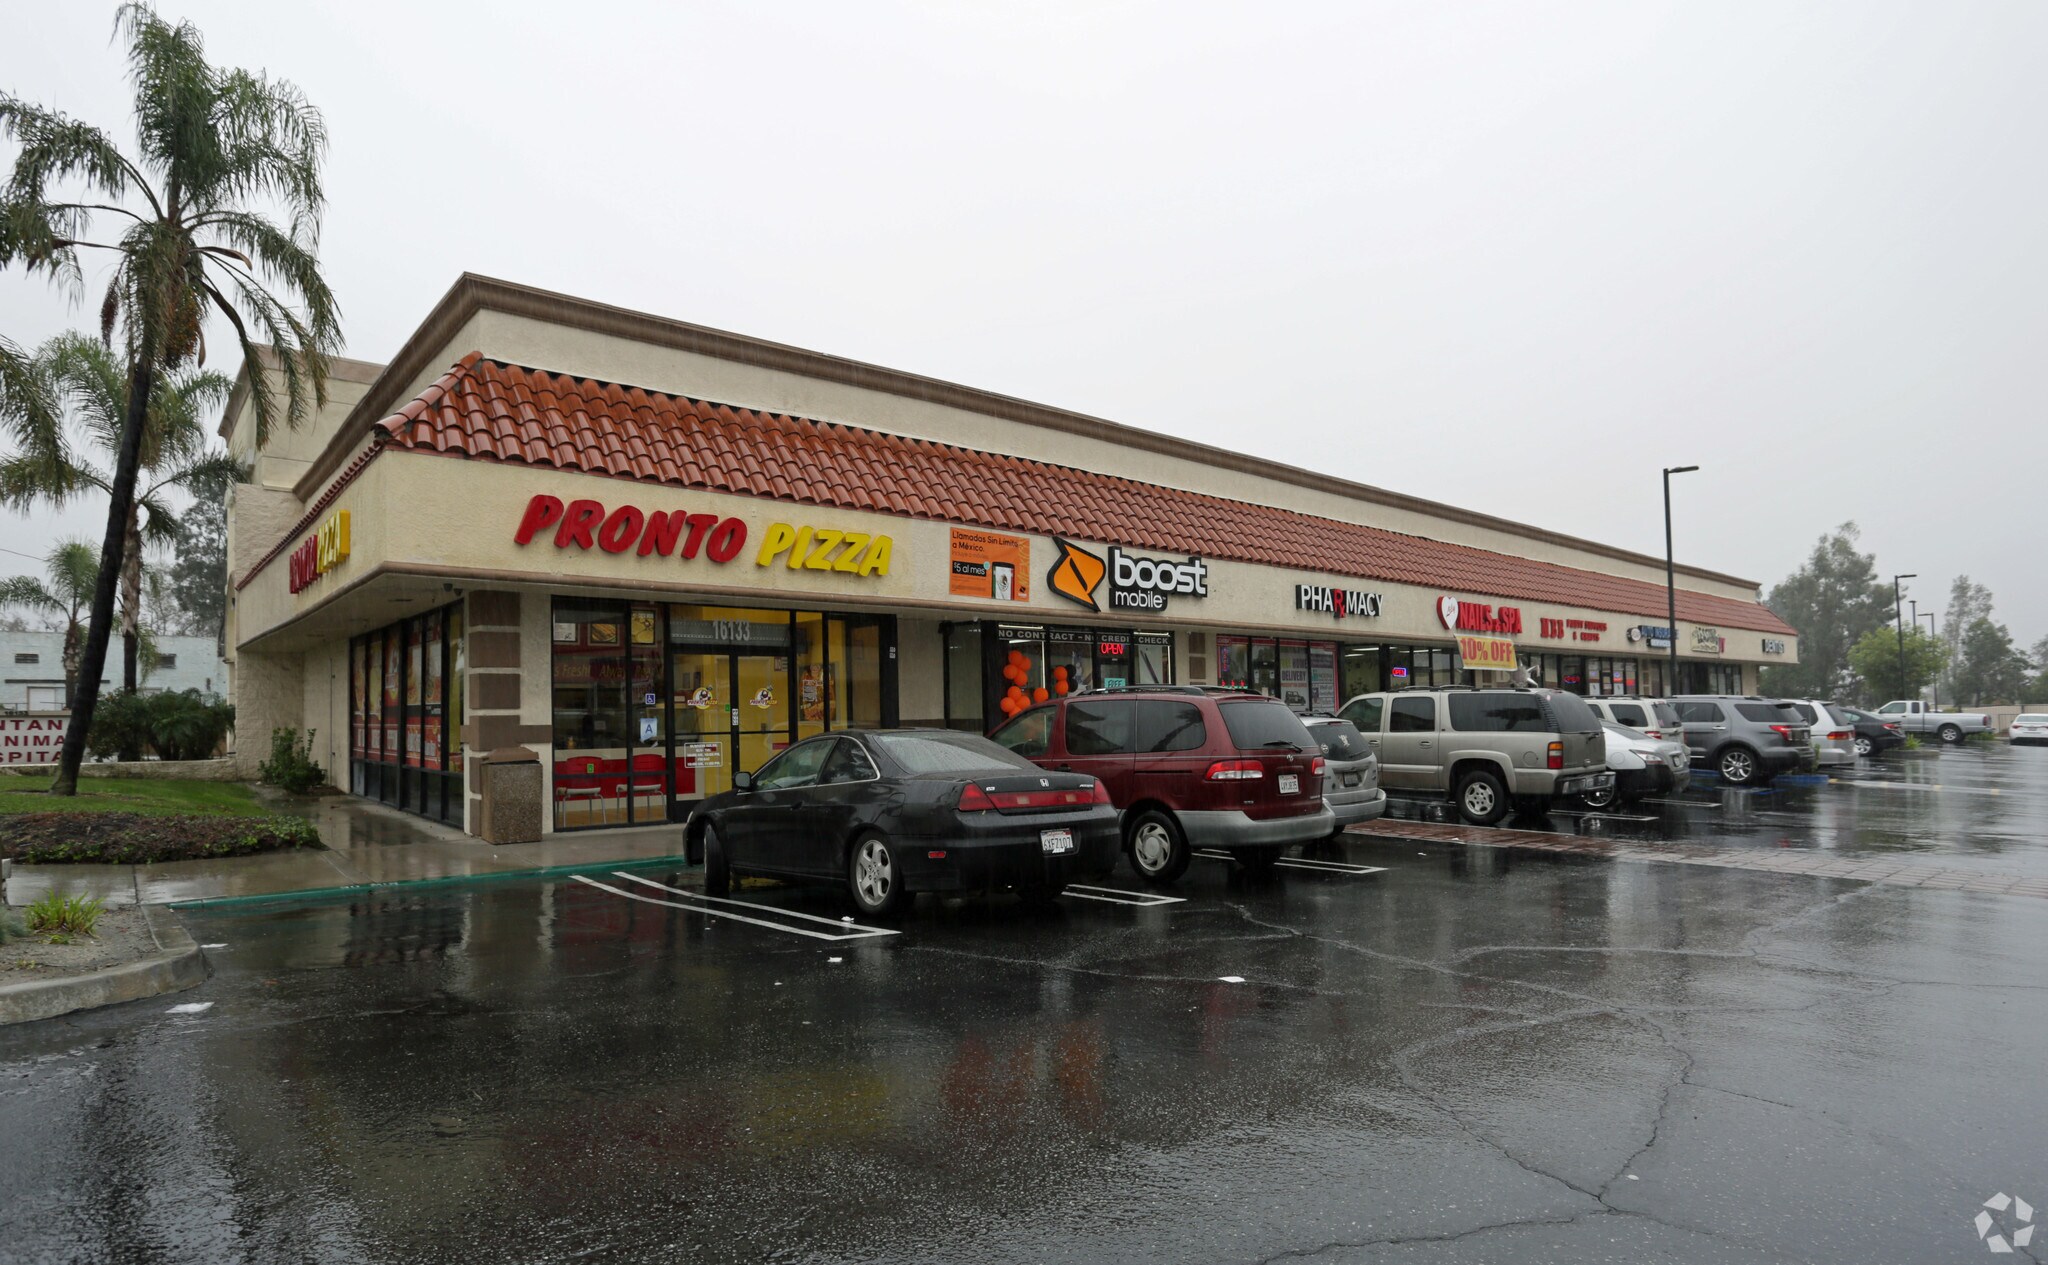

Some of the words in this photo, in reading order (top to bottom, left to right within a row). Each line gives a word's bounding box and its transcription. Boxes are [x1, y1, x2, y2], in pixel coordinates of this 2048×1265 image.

[514, 494, 748, 563] PRONTO
[756, 523, 893, 577] PIZZA
[952, 531, 986, 543] Llamadas
[987, 535, 998, 545] Sin
[953, 561, 962, 573] $5
[962, 564, 969, 573] al
[970, 566, 986, 575] mes
[1114, 549, 1206, 595] boost
[1115, 589, 1163, 609] mobile
[1458, 601, 1493, 631] NAILS
[1500, 606, 1523, 633] SPA
[712, 620, 750, 641] 16133
[998, 629, 1013, 638] NO
[1101, 635, 1131, 643] CREDI
[1138, 636, 1169, 645] CHECK
[1100, 642, 1124, 655] OPEN
[1460, 637, 1488, 660] 10%
[1490, 640, 1513, 662] OFF
[645, 723, 653, 734] A
